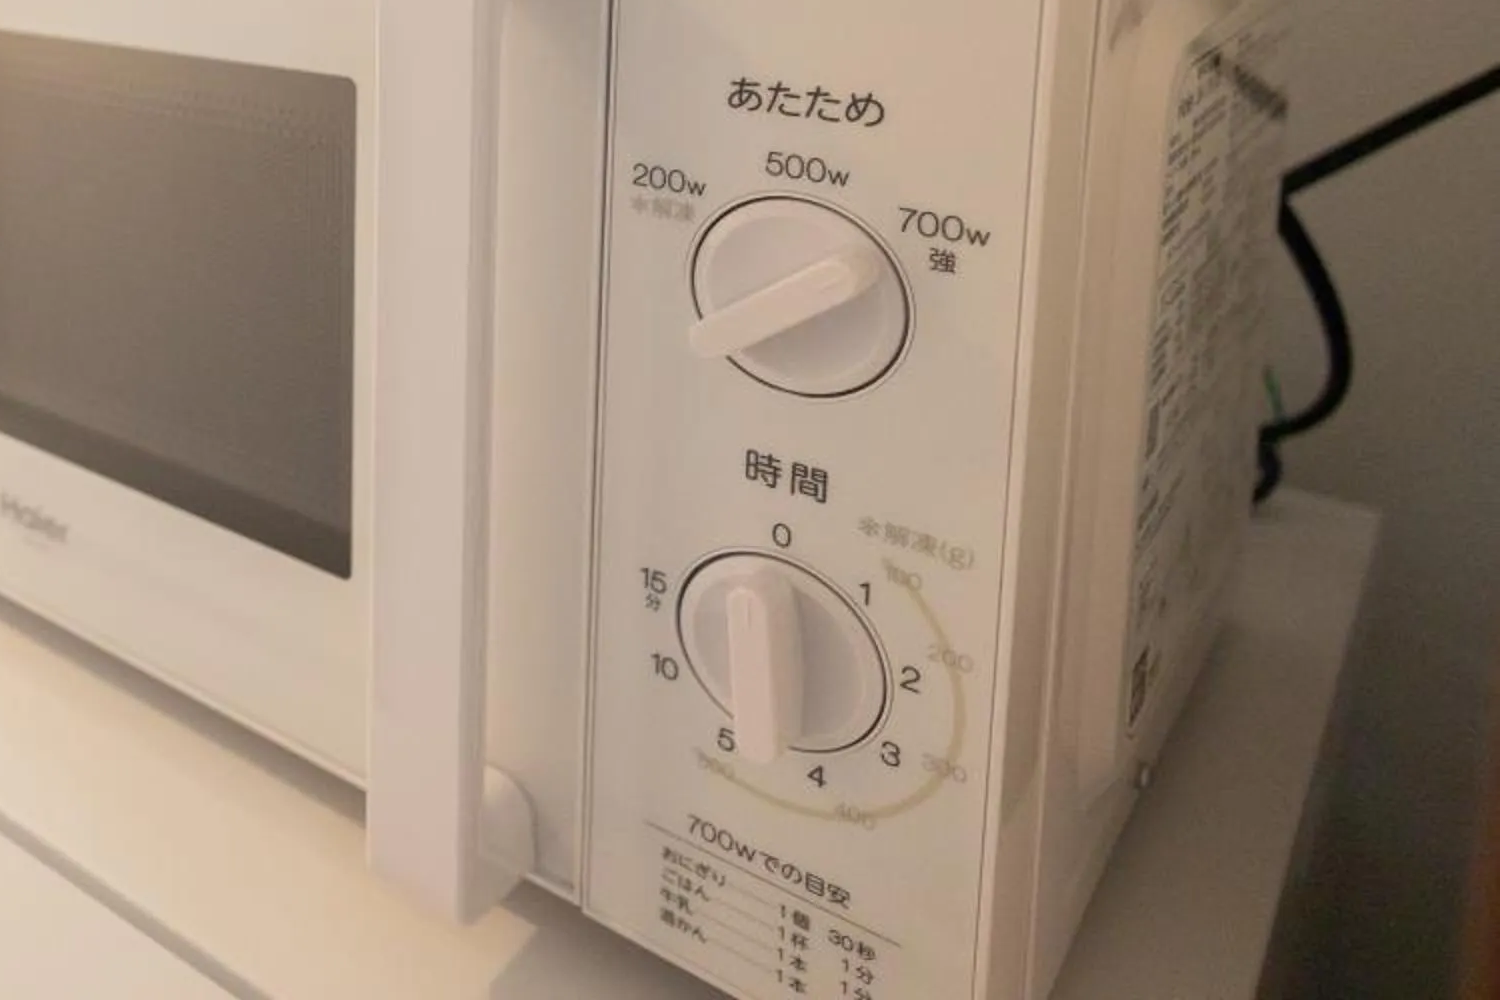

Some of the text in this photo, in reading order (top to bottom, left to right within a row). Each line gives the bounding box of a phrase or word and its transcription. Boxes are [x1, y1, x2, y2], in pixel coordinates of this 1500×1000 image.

[727, 77, 885, 127] あたため
[929, 247, 957, 275] 強
[745, 449, 829, 504] 時間
[772, 523, 792, 548] 0
[640, 567, 667, 594] 15
[859, 582, 871, 606] 1
[651, 653, 679, 681] 10
[900, 666, 921, 694] 2
[717, 728, 736, 752] 5
[880, 741, 901, 767] 3
[807, 765, 827, 788] 4
